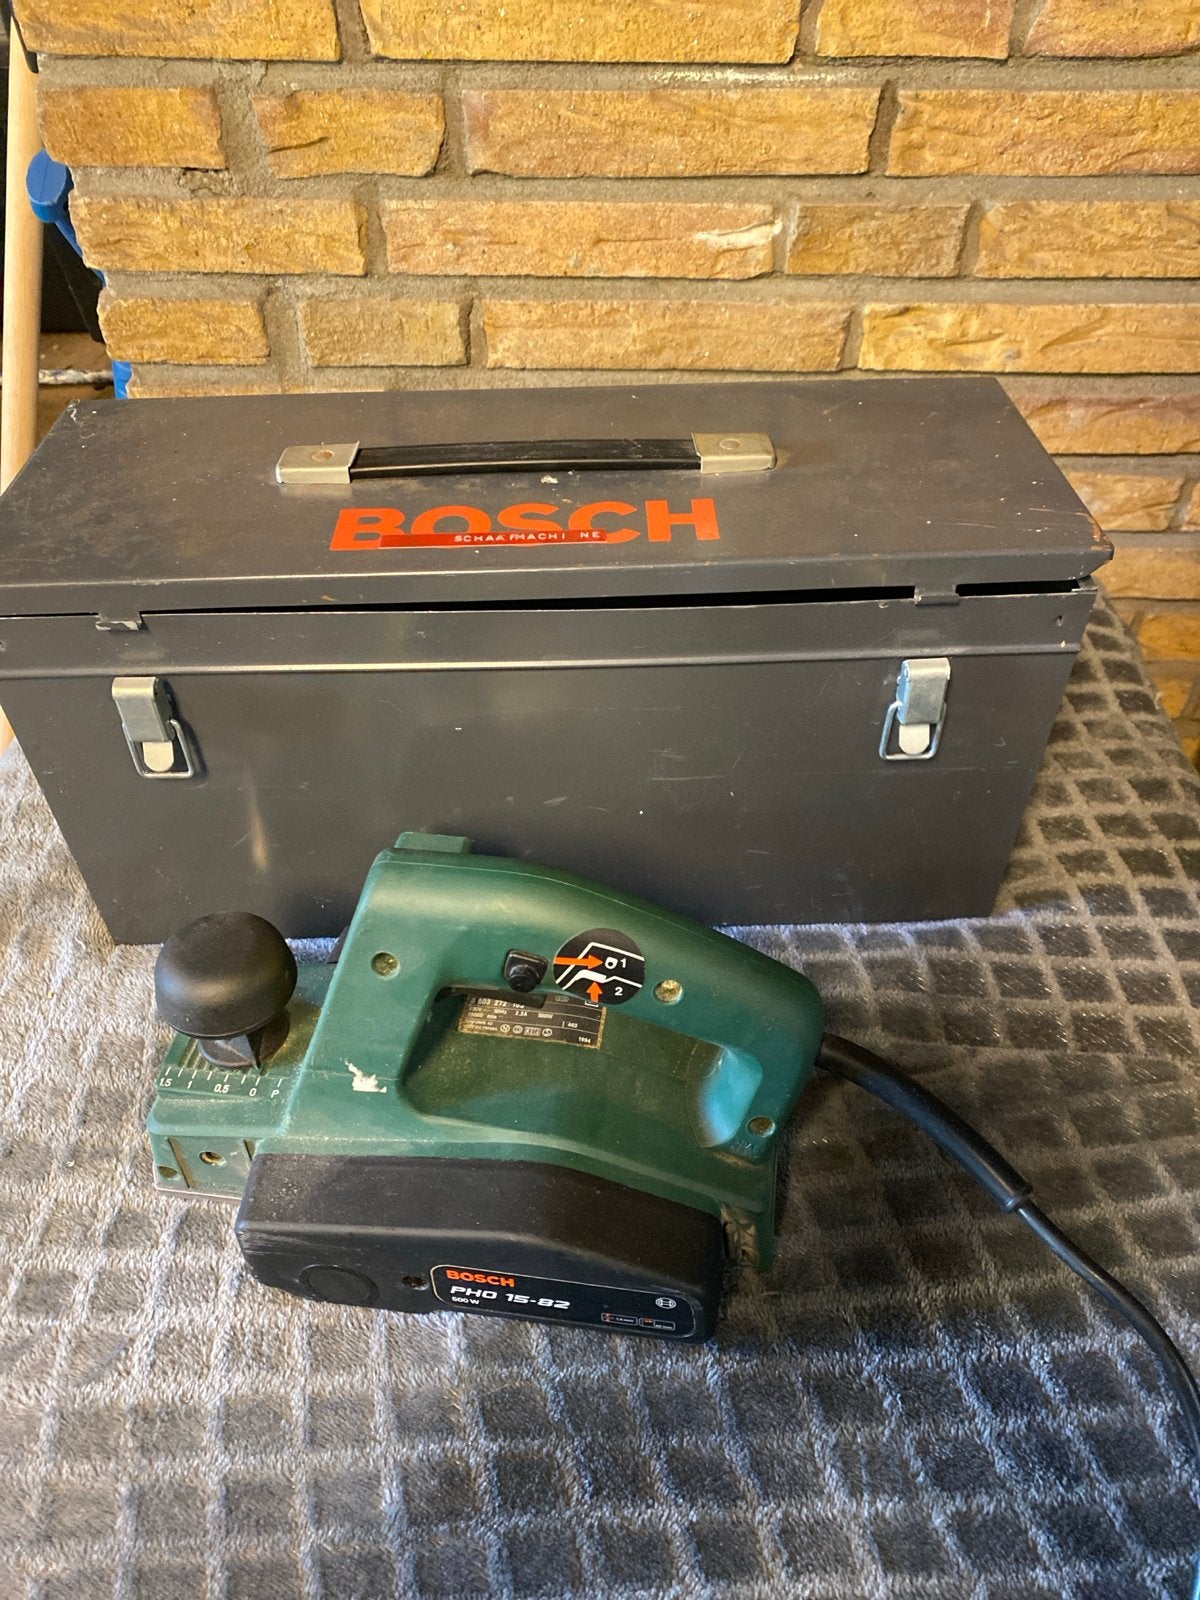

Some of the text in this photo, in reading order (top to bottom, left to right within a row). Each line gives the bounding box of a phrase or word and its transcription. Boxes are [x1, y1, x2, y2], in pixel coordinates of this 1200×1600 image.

[330, 498, 720, 551] BOSCH
[614, 987, 623, 996] 2
[187, 1080, 193, 1090] 1
[271, 1089, 280, 1099] P
[445, 1269, 516, 1288] BOSCH
[450, 1285, 571, 1310] PHO 15-82
[451, 1296, 469, 1304] 500
